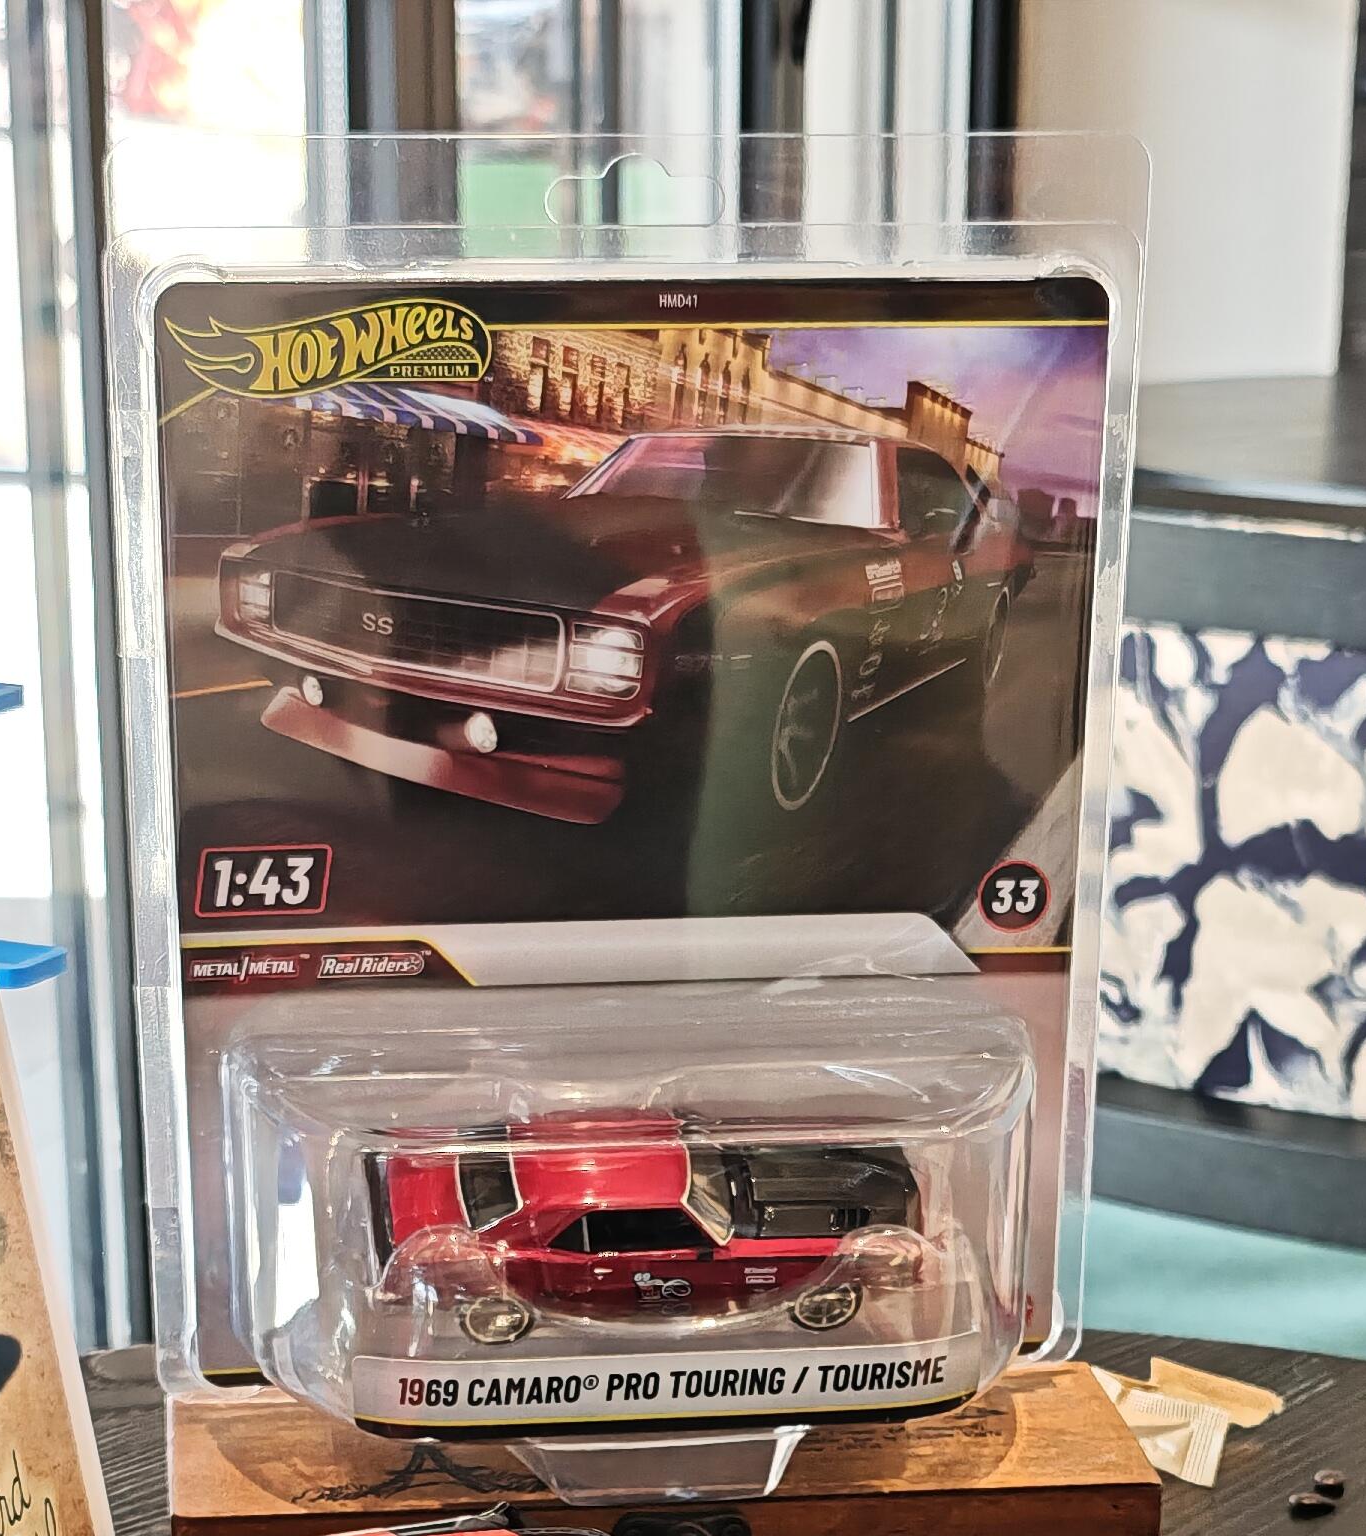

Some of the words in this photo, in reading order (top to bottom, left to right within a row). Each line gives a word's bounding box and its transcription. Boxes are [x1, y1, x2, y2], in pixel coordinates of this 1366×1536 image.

[659, 293, 698, 309] HMD41
[388, 364, 470, 378] PREMIUM
[362, 612, 394, 635] SS
[213, 855, 315, 908] 1:43
[991, 879, 1040, 914] 33
[322, 957, 361, 975] Real
[360, 956, 410, 973] Riders
[398, 1377, 459, 1407] 1969
[605, 1371, 661, 1402] PRO
[670, 1366, 786, 1399] TOURING
[817, 1356, 948, 1394] TOURISME
